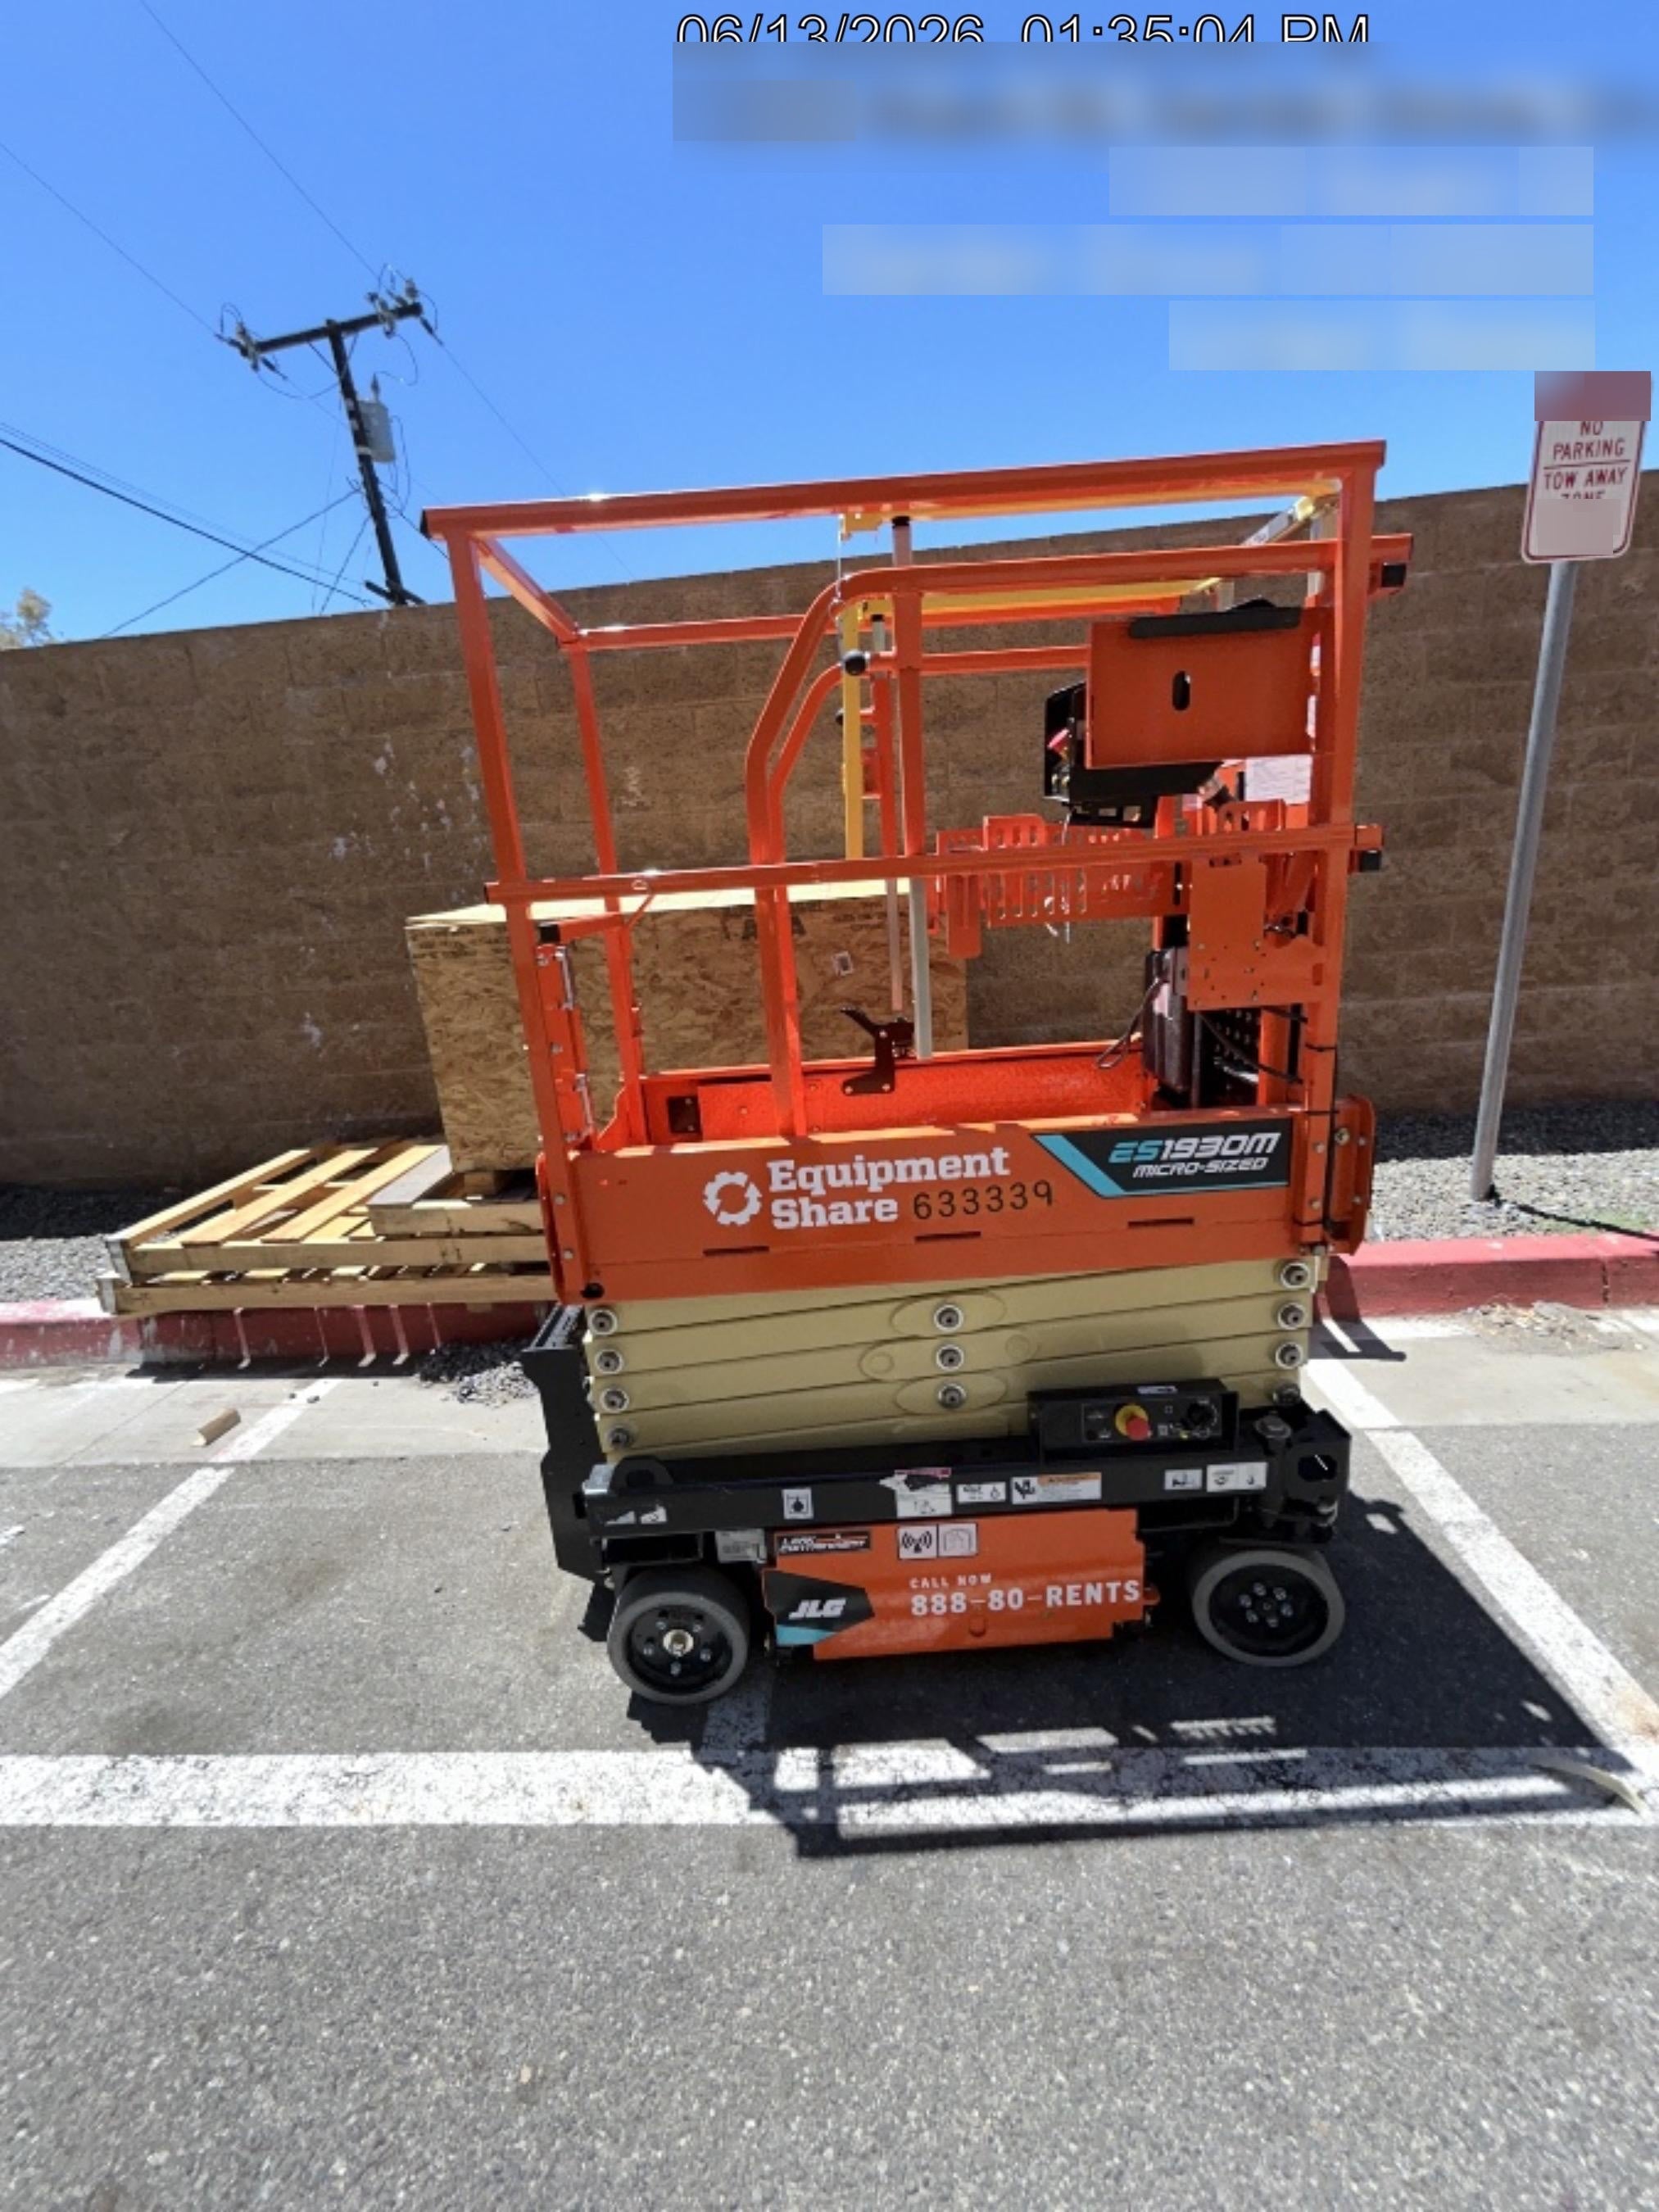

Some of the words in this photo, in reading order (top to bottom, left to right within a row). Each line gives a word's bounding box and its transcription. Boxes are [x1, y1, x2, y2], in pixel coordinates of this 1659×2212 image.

[1580, 420, 1604, 437] NO
[1552, 437, 1625, 460] PARKING
[1543, 470, 1578, 490] TOW
[1584, 466, 1628, 487] AWAY
[1108, 1132, 1281, 1163] ES1930M
[767, 1147, 1010, 1194] Equipment
[1132, 1156, 1269, 1178] MICRO-SIZED
[913, 1180, 1054, 1220] 633339
[771, 1197, 899, 1229] Share
[909, 1576, 950, 1589] CALL
[958, 1573, 992, 1586] NOW
[788, 1598, 846, 1620] JLG
[911, 1580, 1140, 1616] 888-80-RENTS
